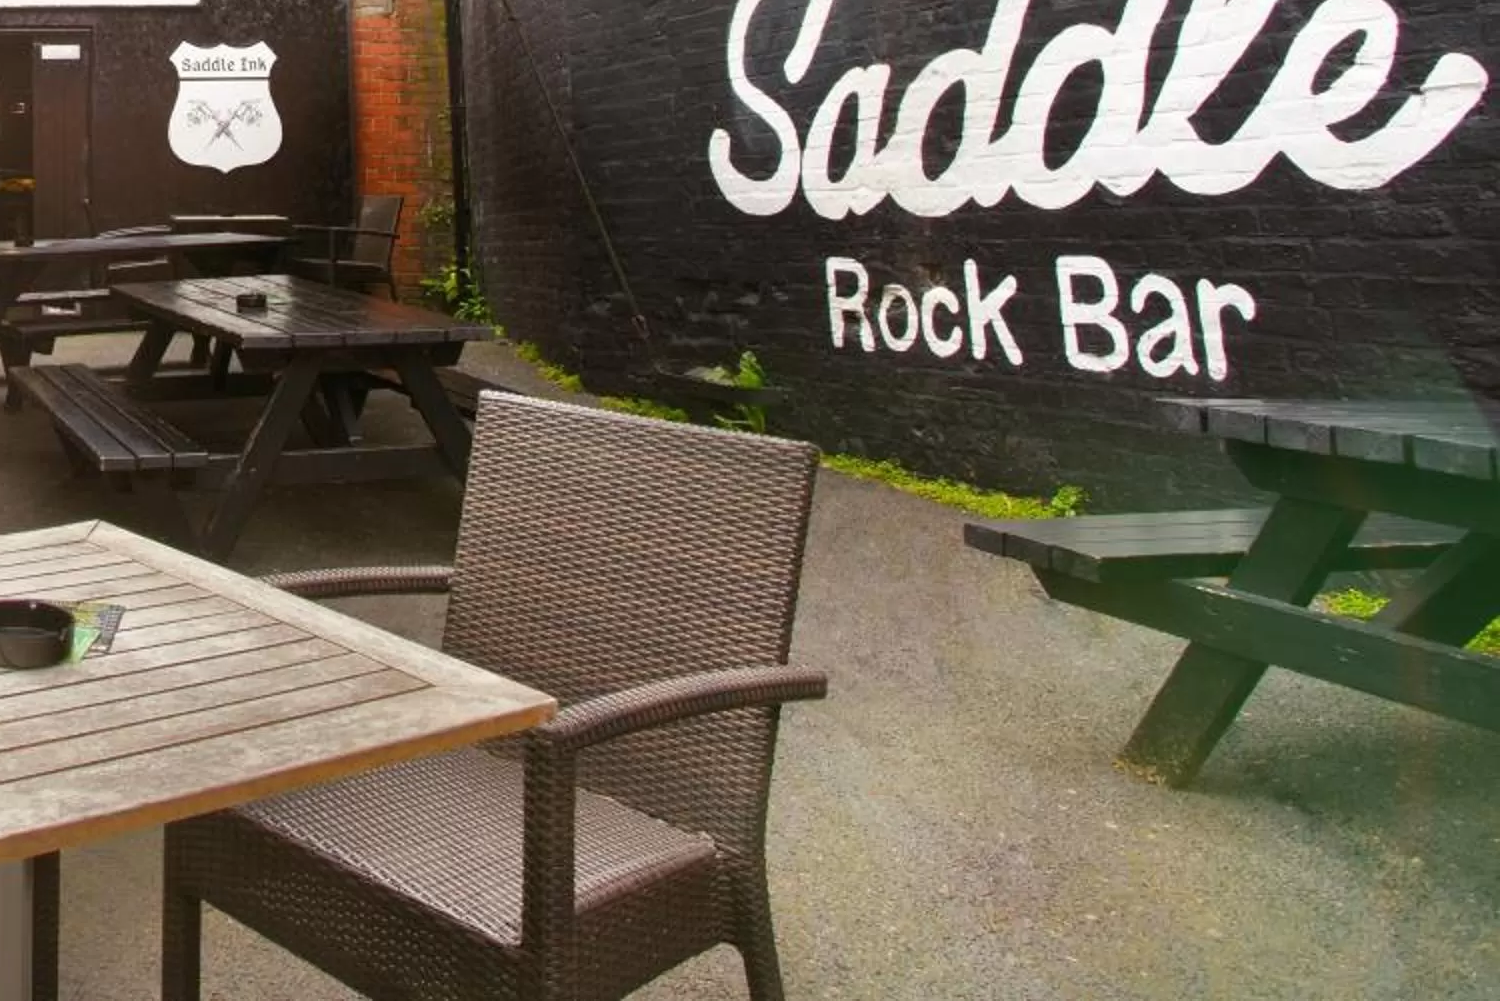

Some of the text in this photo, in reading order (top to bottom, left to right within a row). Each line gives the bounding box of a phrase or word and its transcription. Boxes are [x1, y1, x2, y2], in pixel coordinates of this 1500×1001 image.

[181, 57, 268, 72] Saddle Ink
[825, 255, 1256, 383] Rock Bar
